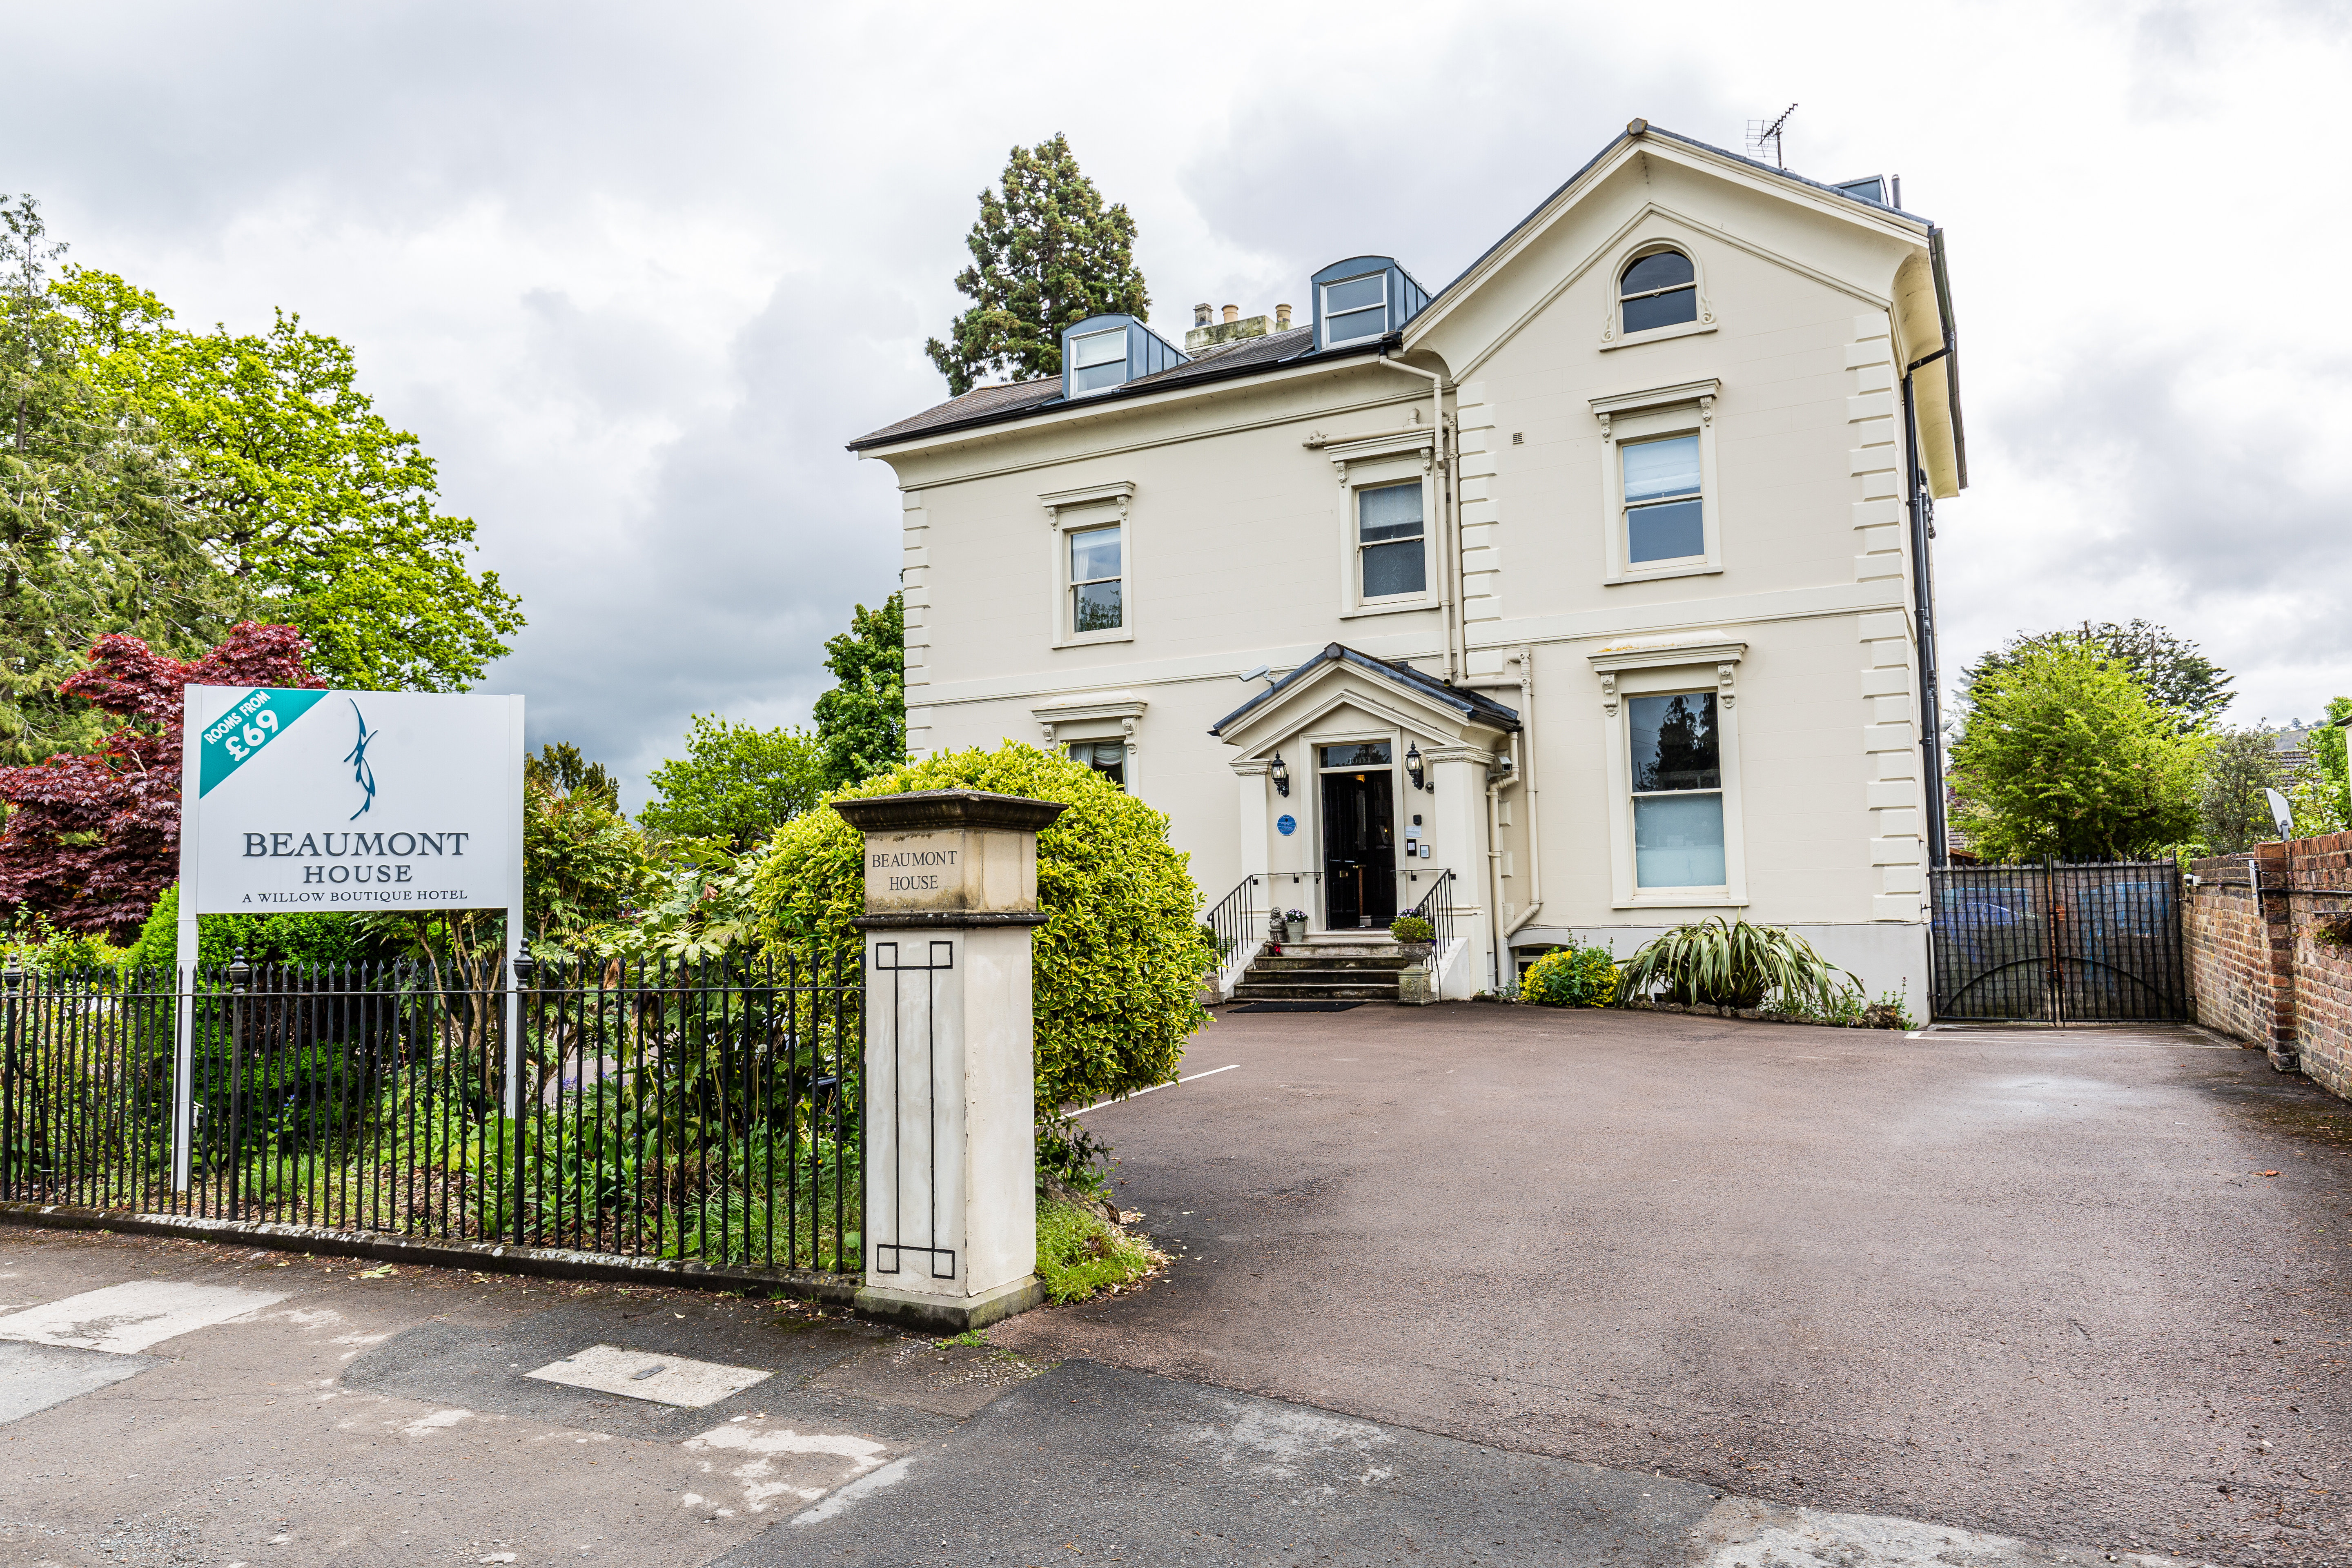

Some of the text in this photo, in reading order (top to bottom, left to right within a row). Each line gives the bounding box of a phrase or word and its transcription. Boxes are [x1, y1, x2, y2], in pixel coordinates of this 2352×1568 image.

[203, 690, 271, 745] ROOMS FROM
[225, 709, 278, 762] £69
[1346, 756, 1373, 764] HOTEL
[243, 832, 469, 857] BEAUMONT
[871, 851, 957, 868] BEAUMONT
[303, 864, 412, 883] HOUSE
[889, 875, 938, 891] HOUSE
[242, 890, 468, 903] A WILLOW BOUTIQUE HOTEL
